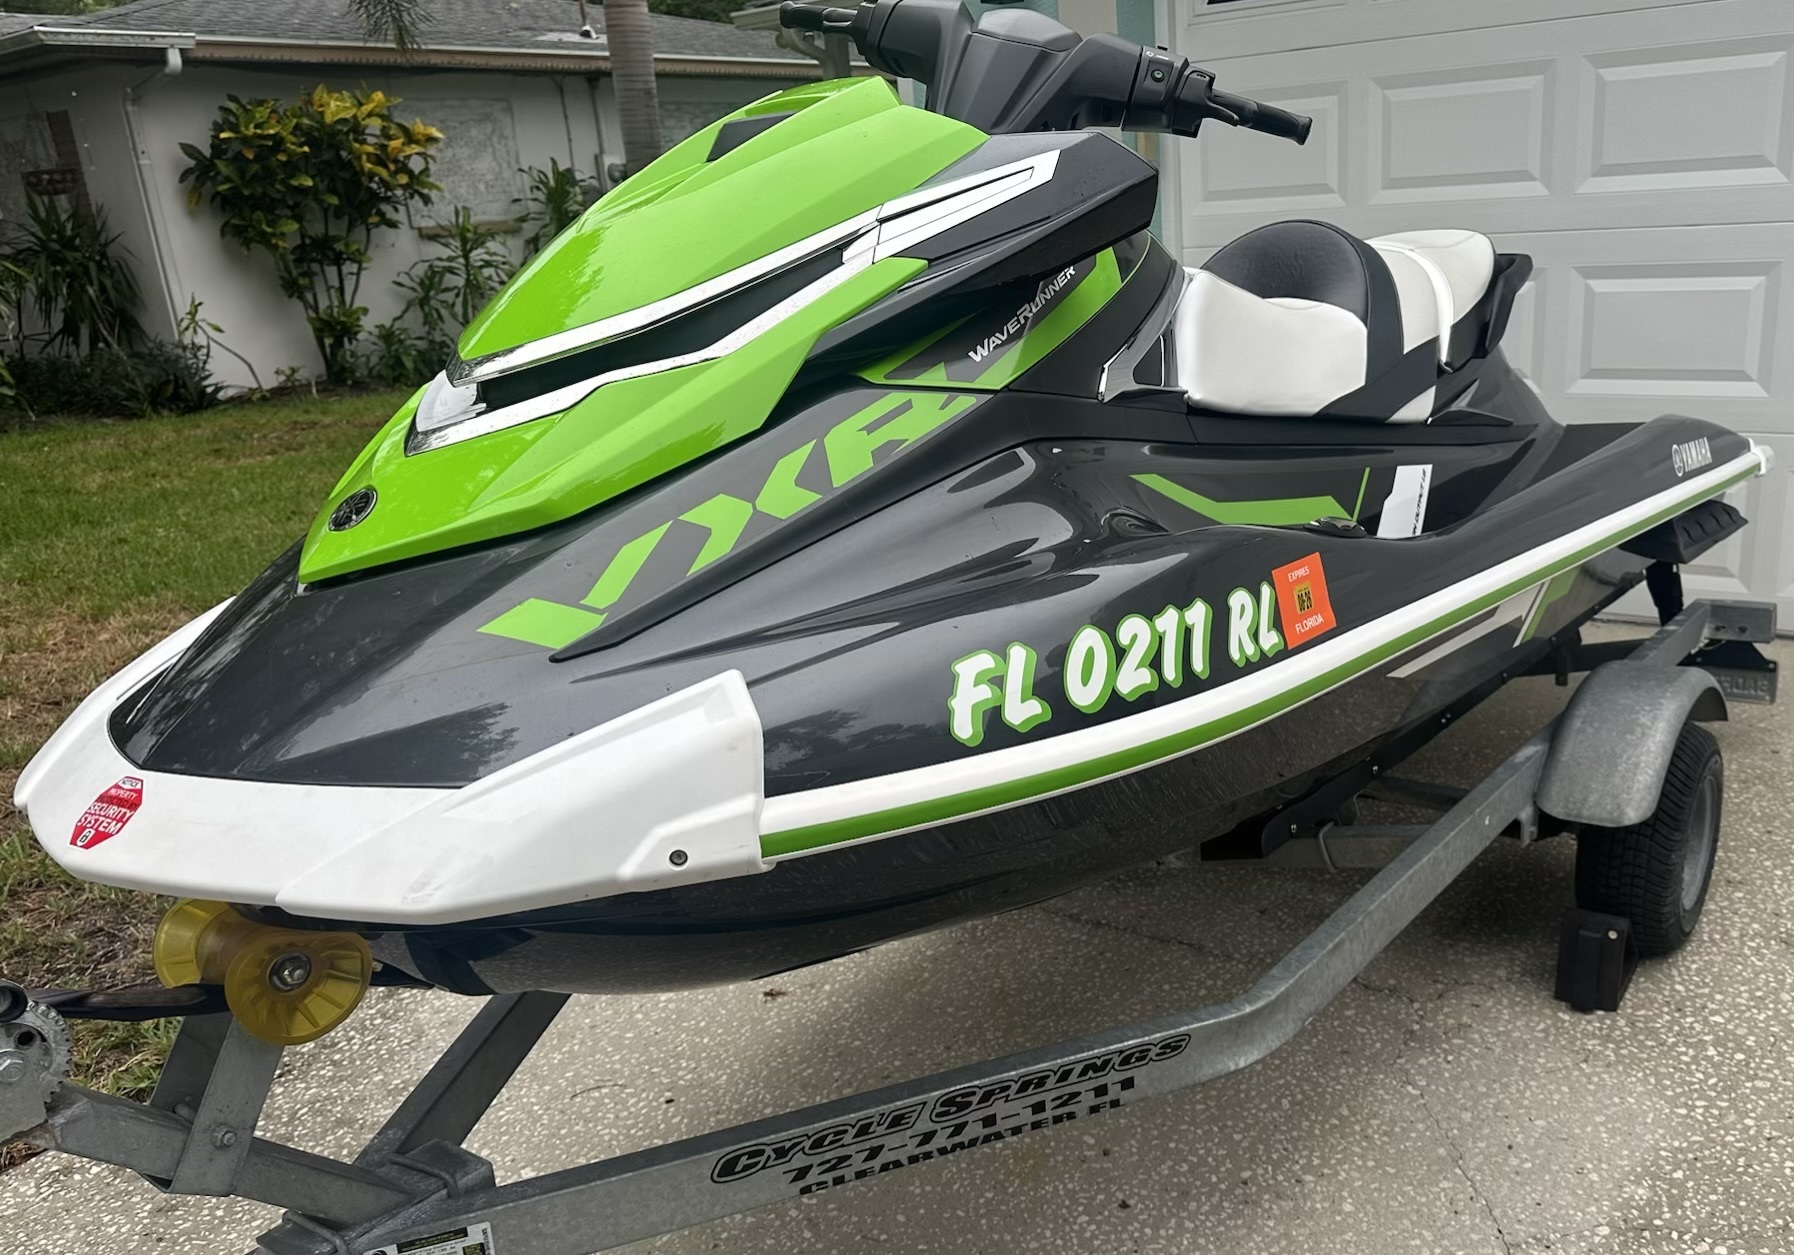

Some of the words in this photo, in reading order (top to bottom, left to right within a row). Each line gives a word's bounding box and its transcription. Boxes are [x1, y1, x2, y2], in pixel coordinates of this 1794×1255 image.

[1679, 436, 1712, 472] YAMAHA
[477, 391, 977, 650] VXR
[1288, 565, 1310, 583] EXPIRES
[1295, 613, 1324, 635] FLORIDA
[949, 642, 1051, 746] FL
[1064, 598, 1212, 713] 0211
[1227, 581, 1284, 667] RL
[107, 788, 138, 800] PROPERTY
[121, 779, 140, 788] NOTICE
[77, 814, 123, 834] SYSTEM
[87, 802, 134, 821] SECURITY
[711, 1102, 927, 1183] CYCLE
[930, 1034, 1191, 1122] SPRINGS
[782, 1076, 1135, 1184] 727-771-1211
[799, 1110, 1076, 1196] CLEARWATER
[1089, 1098, 1127, 1115] FL
